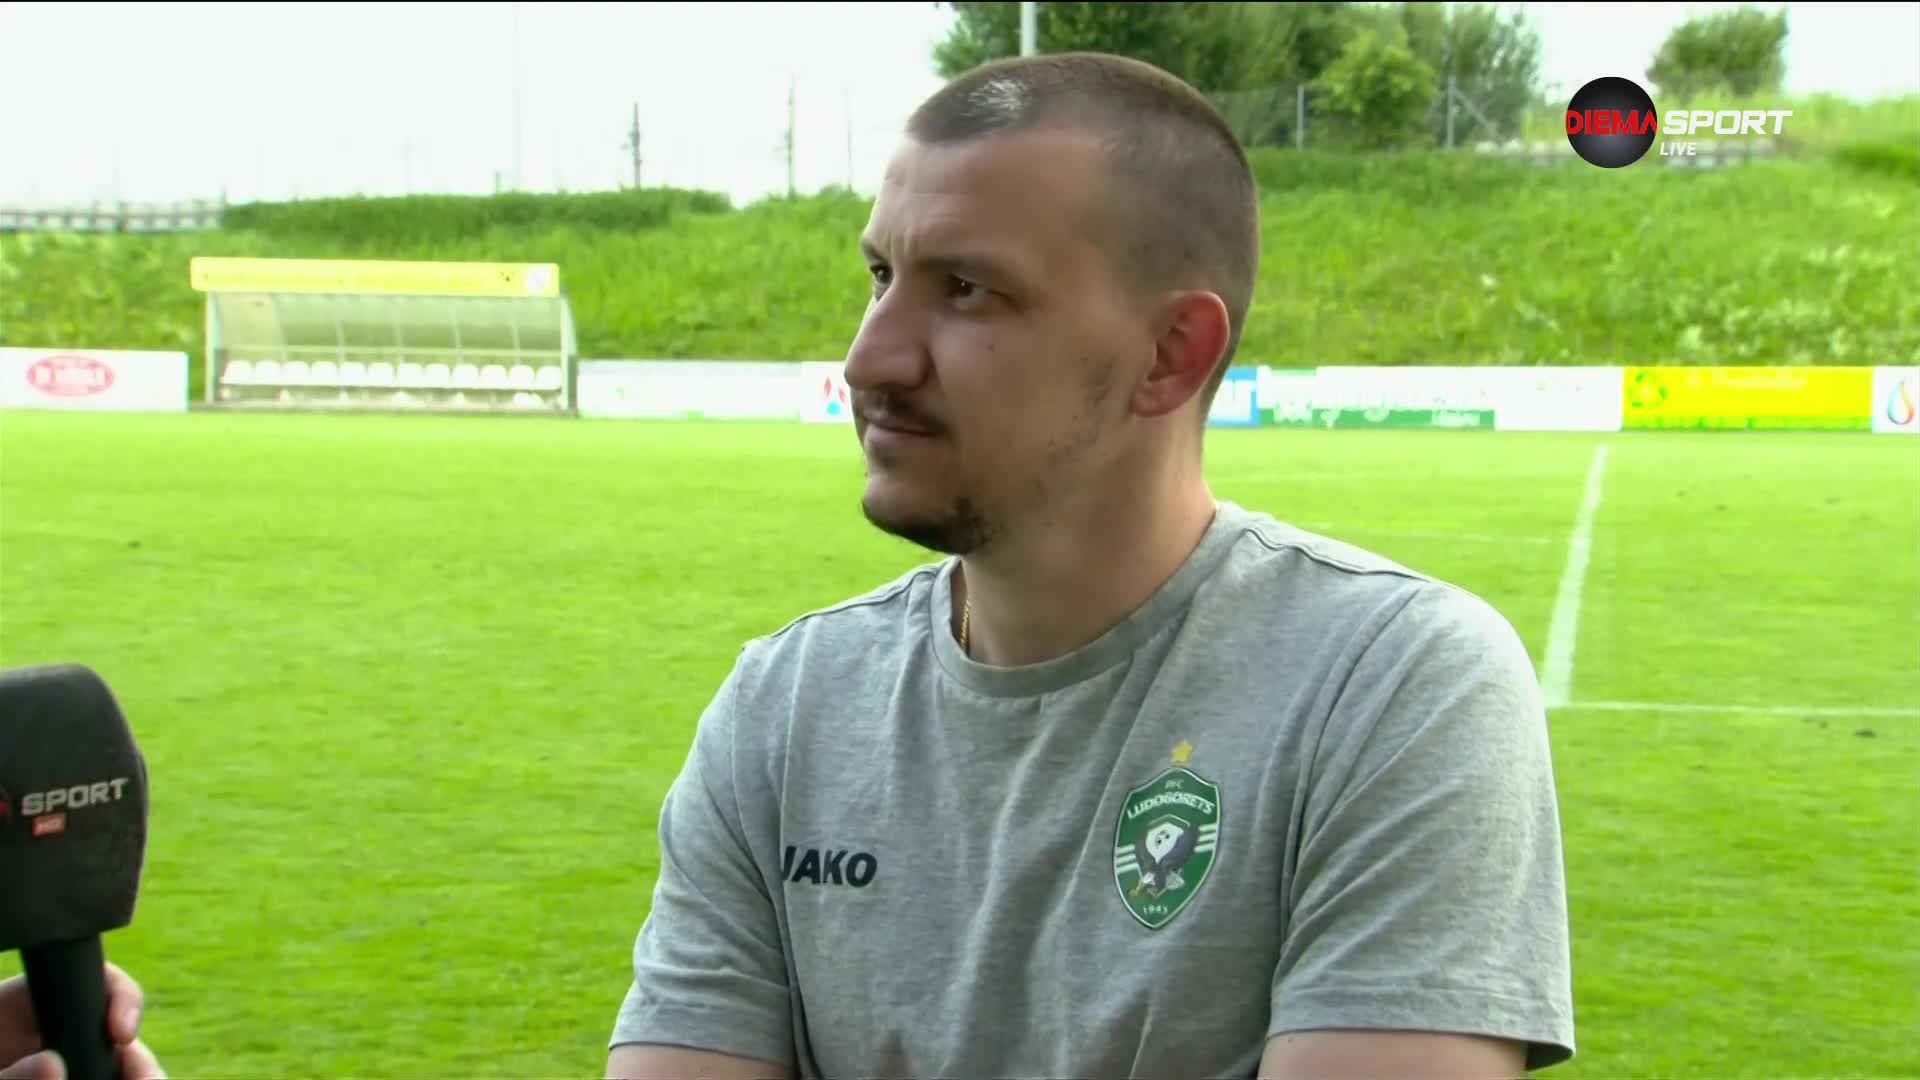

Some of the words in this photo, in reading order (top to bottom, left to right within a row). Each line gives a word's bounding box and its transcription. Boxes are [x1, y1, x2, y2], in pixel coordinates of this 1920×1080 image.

[21, 777, 129, 816] SPORT
[1127, 791, 1216, 820] LUDOGORETS
[782, 845, 878, 888] JAKO
